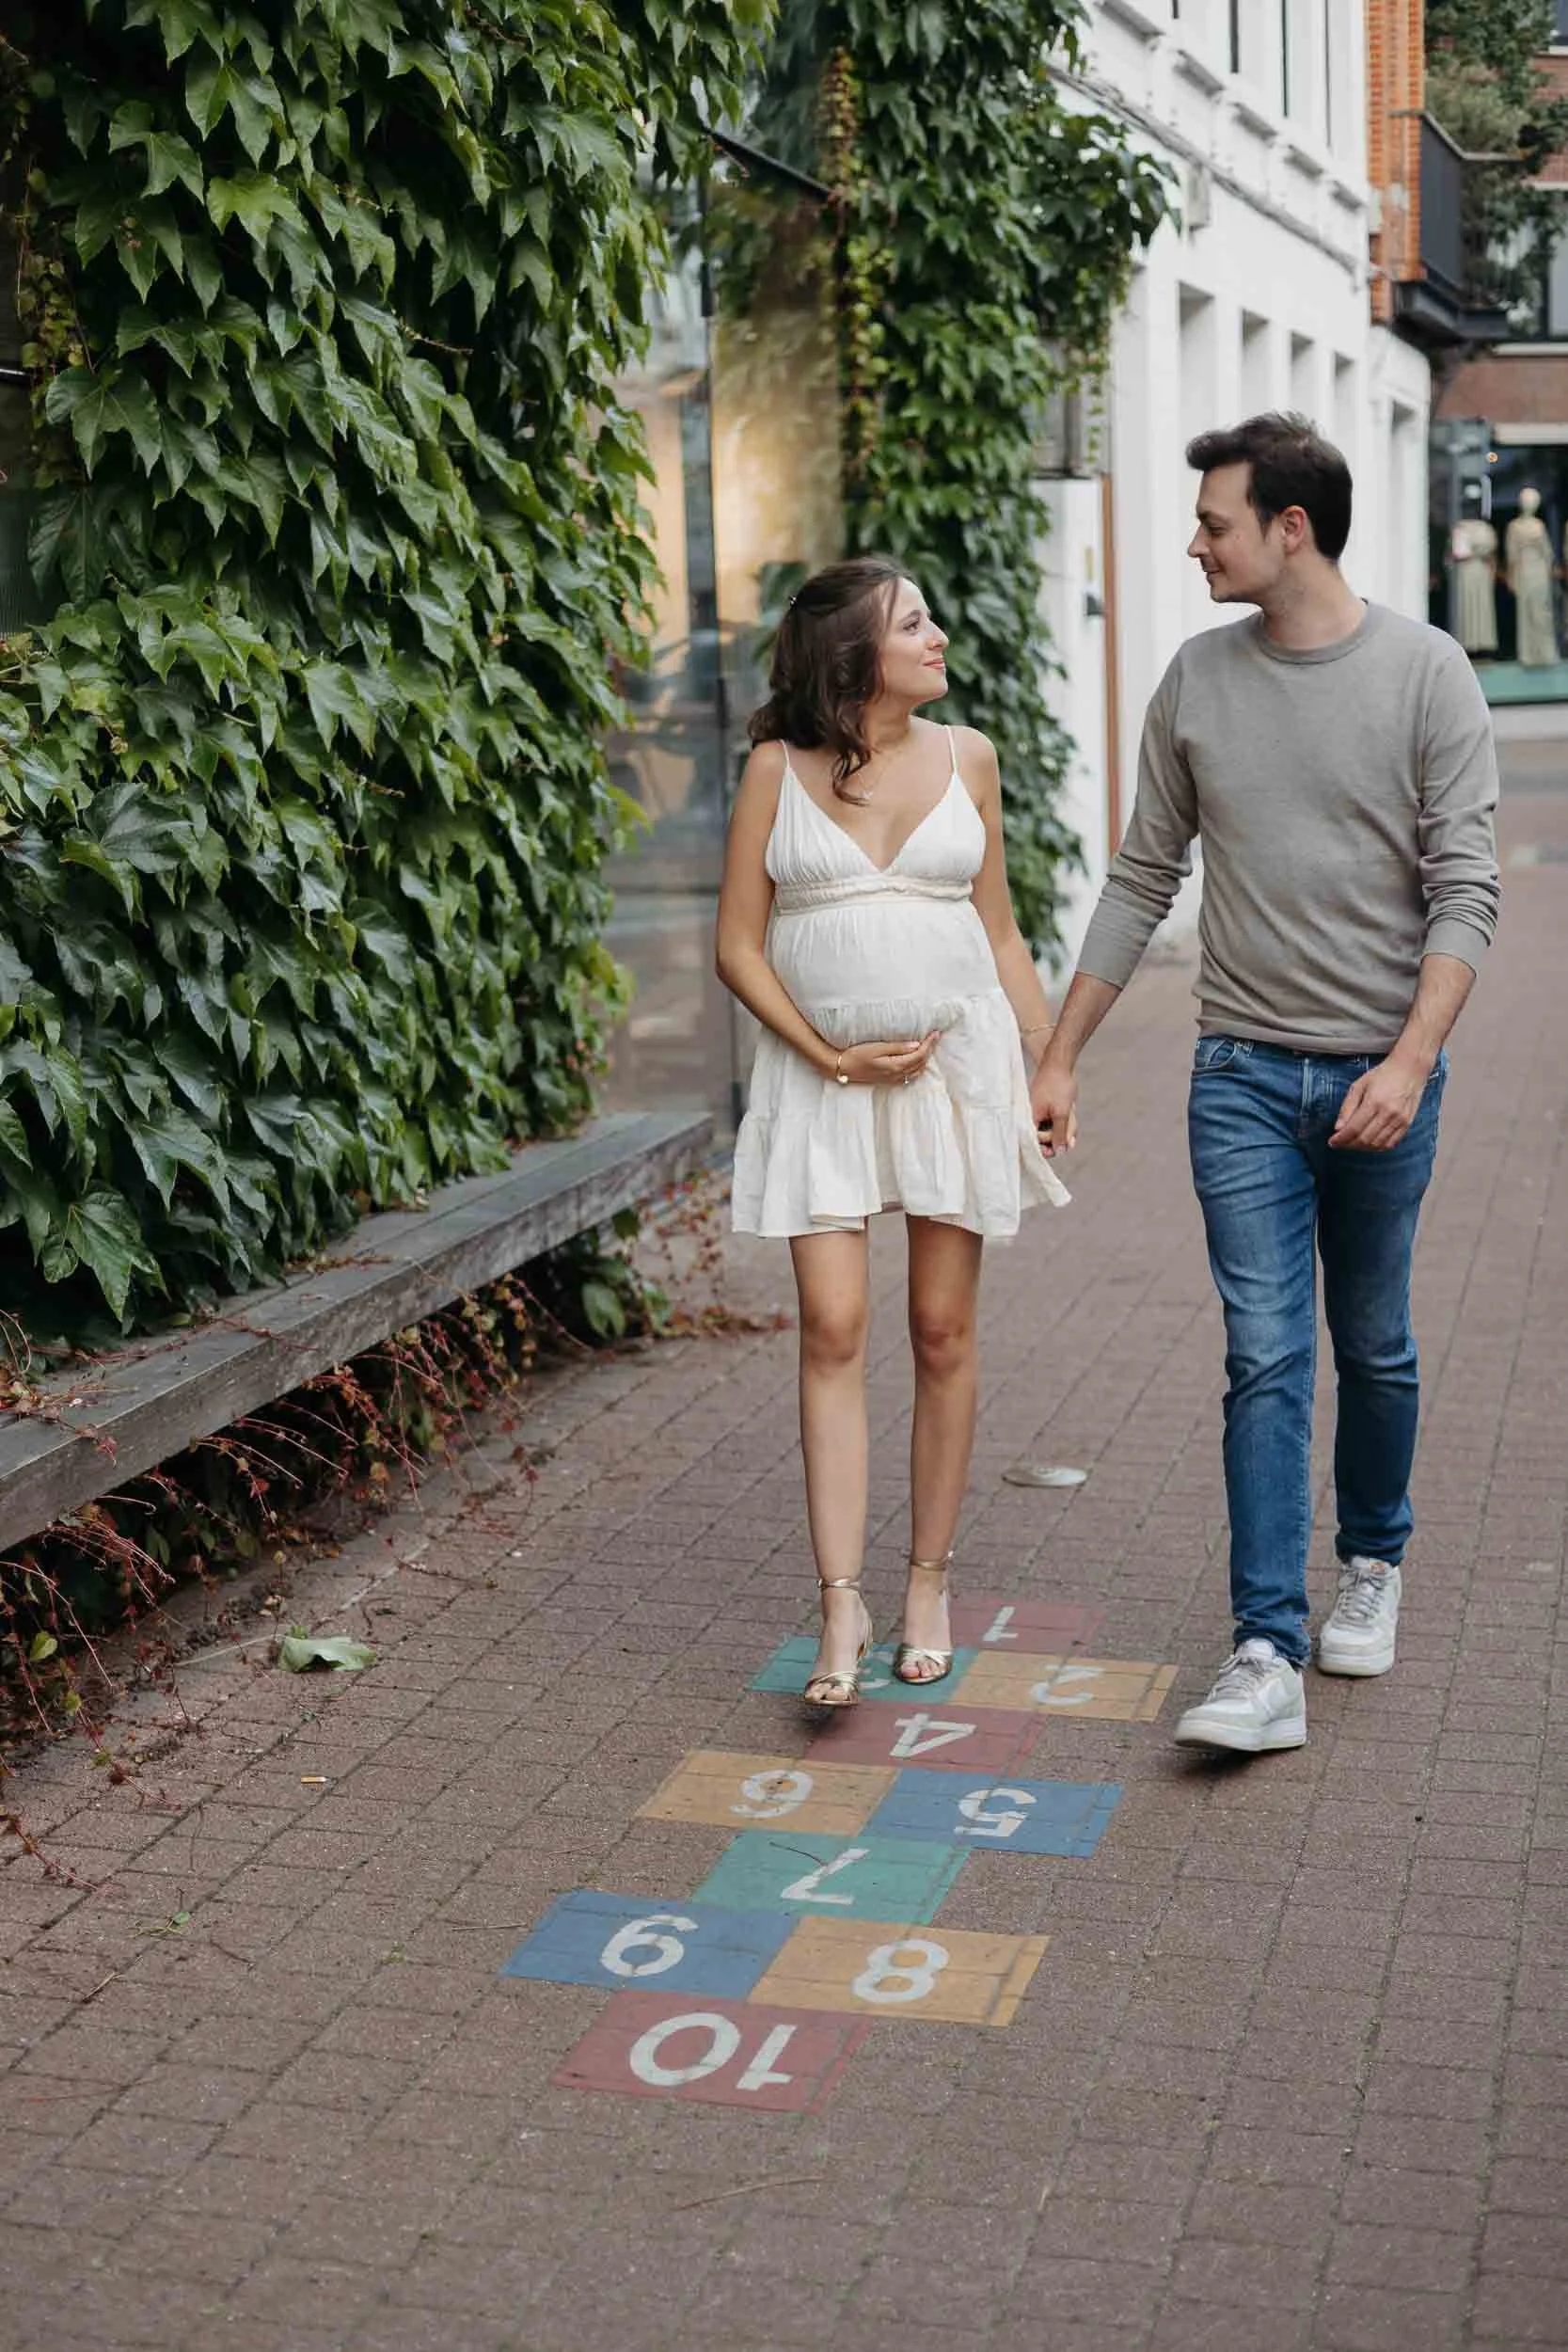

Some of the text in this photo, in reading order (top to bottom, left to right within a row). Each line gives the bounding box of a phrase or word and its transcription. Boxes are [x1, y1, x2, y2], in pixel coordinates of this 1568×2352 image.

[982, 1606, 1019, 1643] 1
[1028, 1664, 1105, 1706] 2
[889, 1713, 977, 1757] 4
[954, 1788, 1037, 1837] 5
[780, 1848, 870, 1905] 7
[850, 1938, 950, 2004] 8
[629, 2012, 798, 2090] 10
